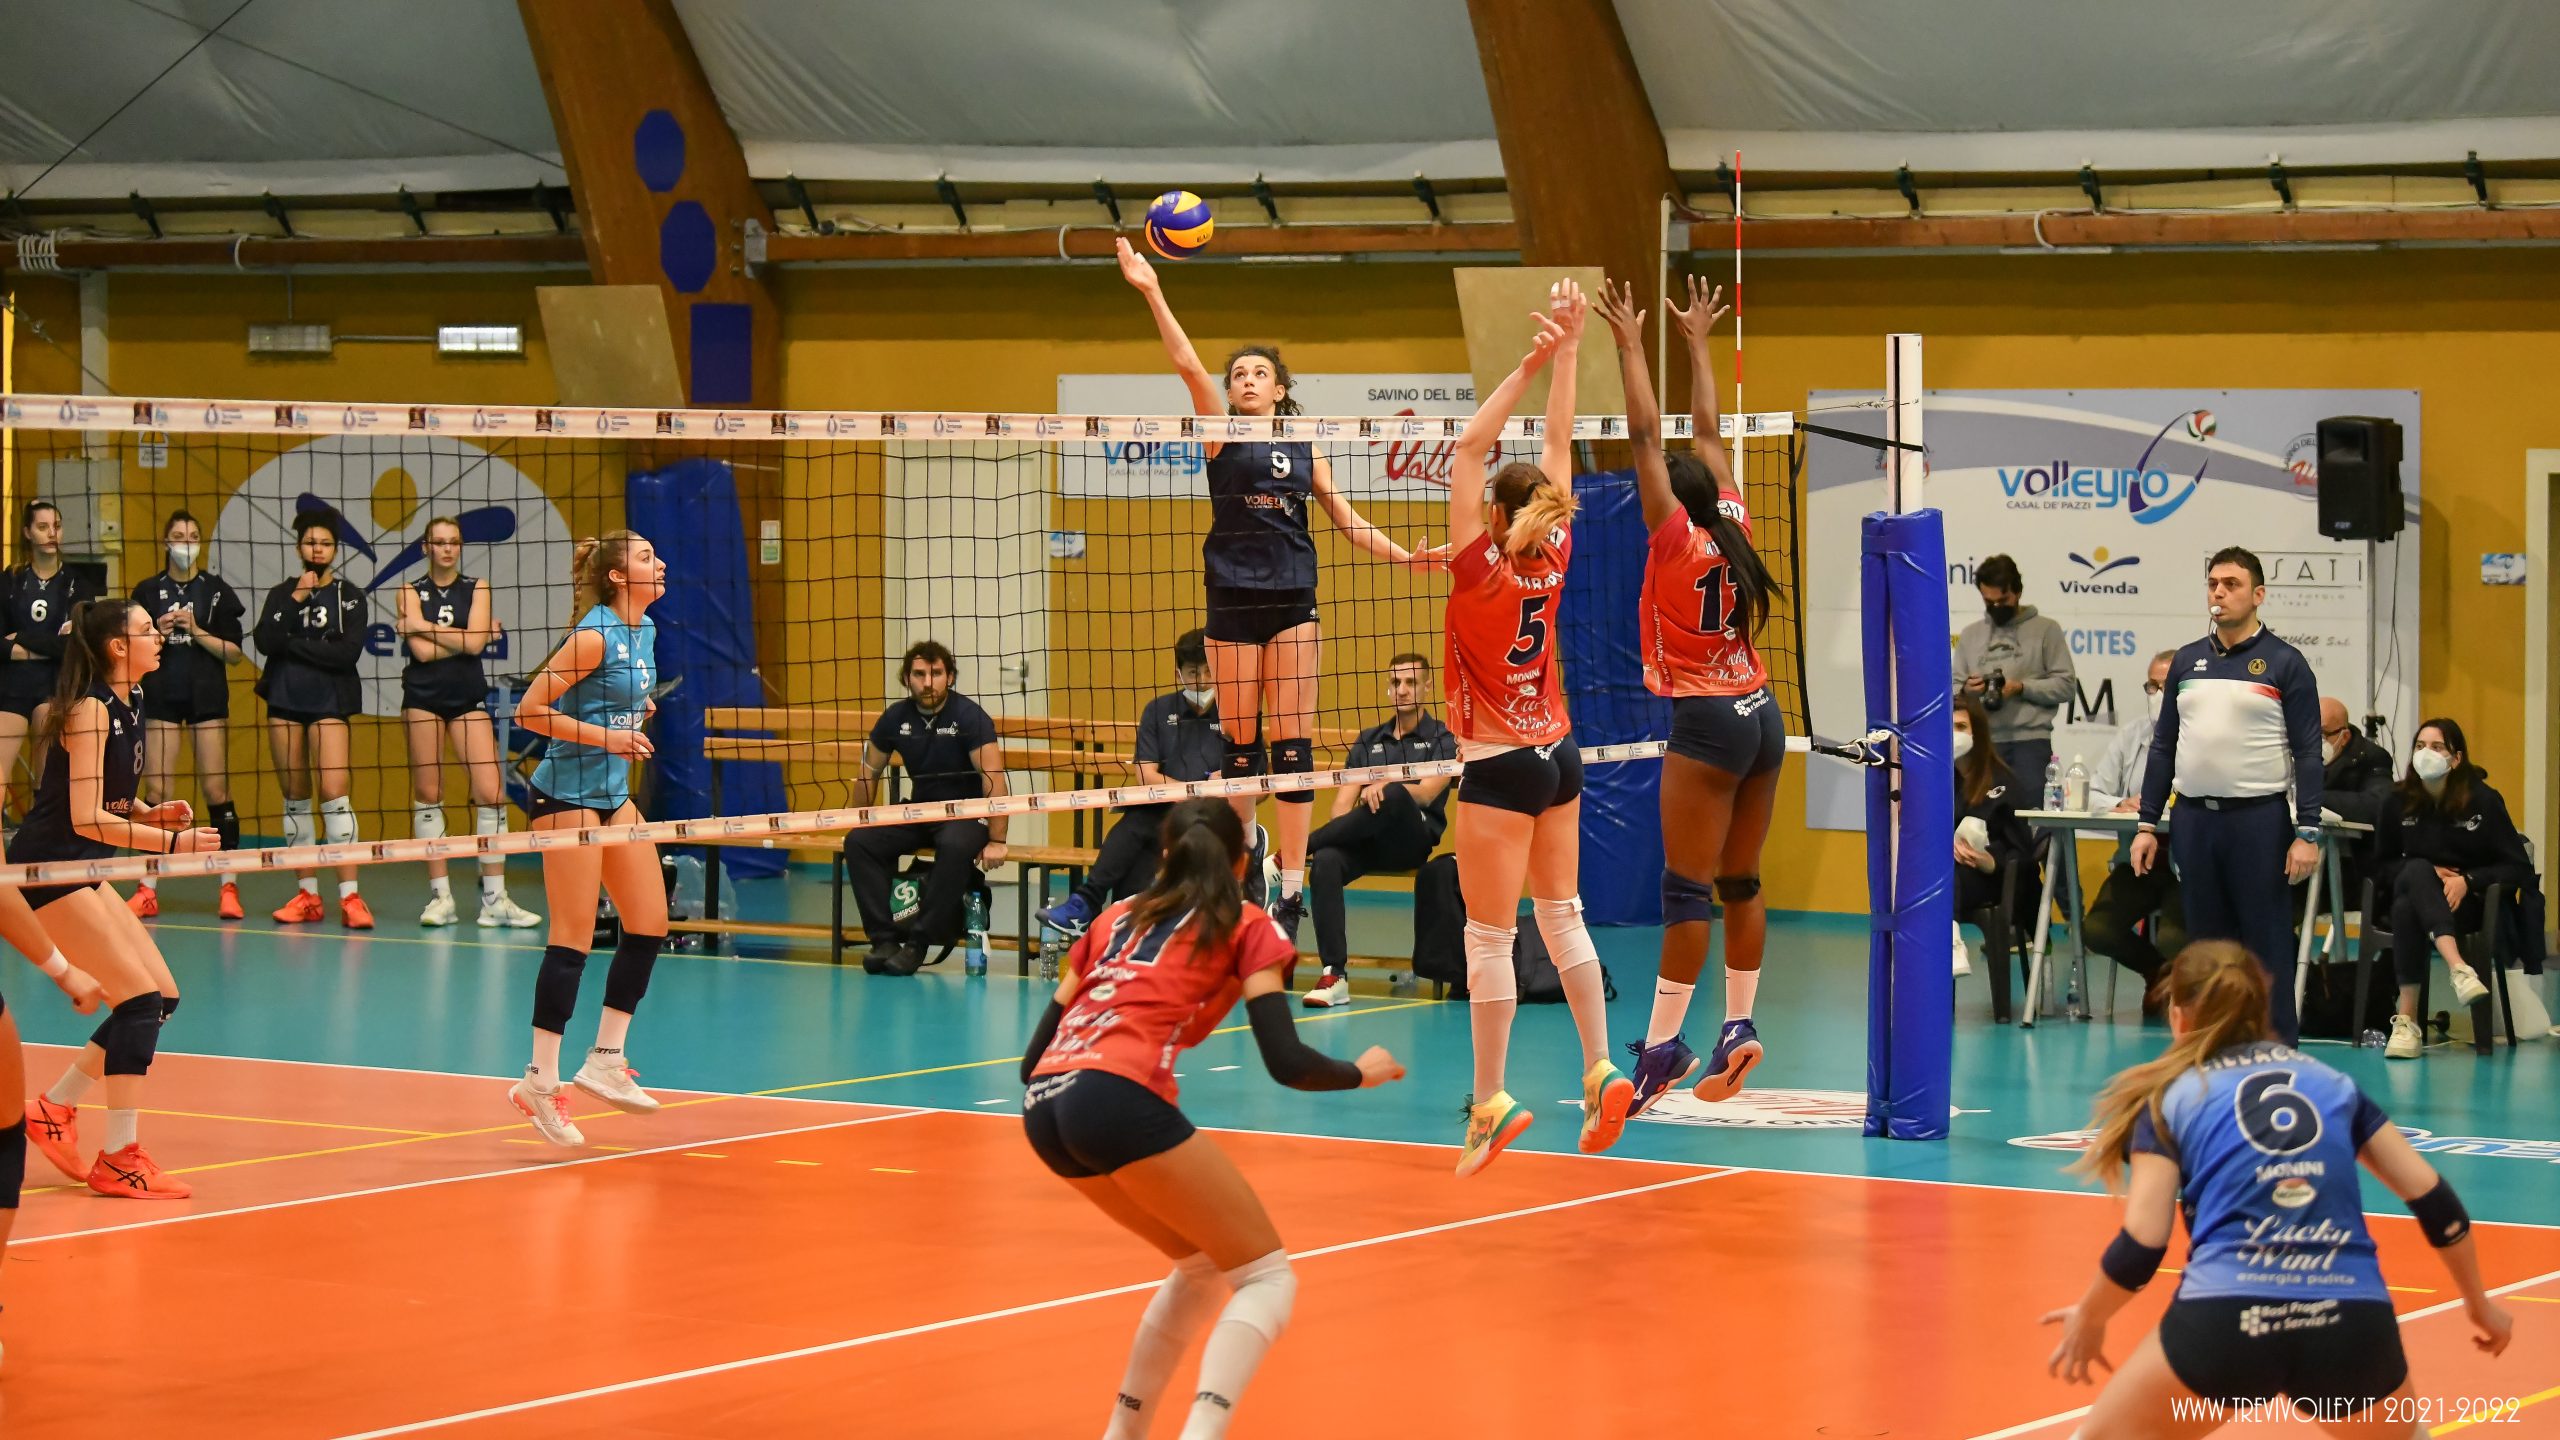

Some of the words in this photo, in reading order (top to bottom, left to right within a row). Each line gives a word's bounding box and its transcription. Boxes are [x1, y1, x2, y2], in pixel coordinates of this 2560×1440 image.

[1368, 389, 1419, 401] SAVINO
[1424, 389, 1450, 401] DEL
[1456, 389, 1475, 401] BE
[1109, 468, 1136, 477] CASAL
[1153, 468, 1179, 477] PAZZI
[1272, 451, 1291, 479] 9
[2006, 500, 2040, 510] CASAL
[2061, 501, 2091, 510] PAZZI
[2059, 580, 2138, 594] Vivenda
[31, 599, 48, 622] 6
[299, 606, 328, 628] 13
[437, 605, 454, 627] 5
[1504, 594, 1551, 667] 5
[2064, 629, 2137, 656] CITES
[636, 658, 650, 690] 3
[133, 739, 144, 775] 8
[2234, 1068, 2324, 1156] 6
[2238, 1214, 2353, 1247] Lucky
